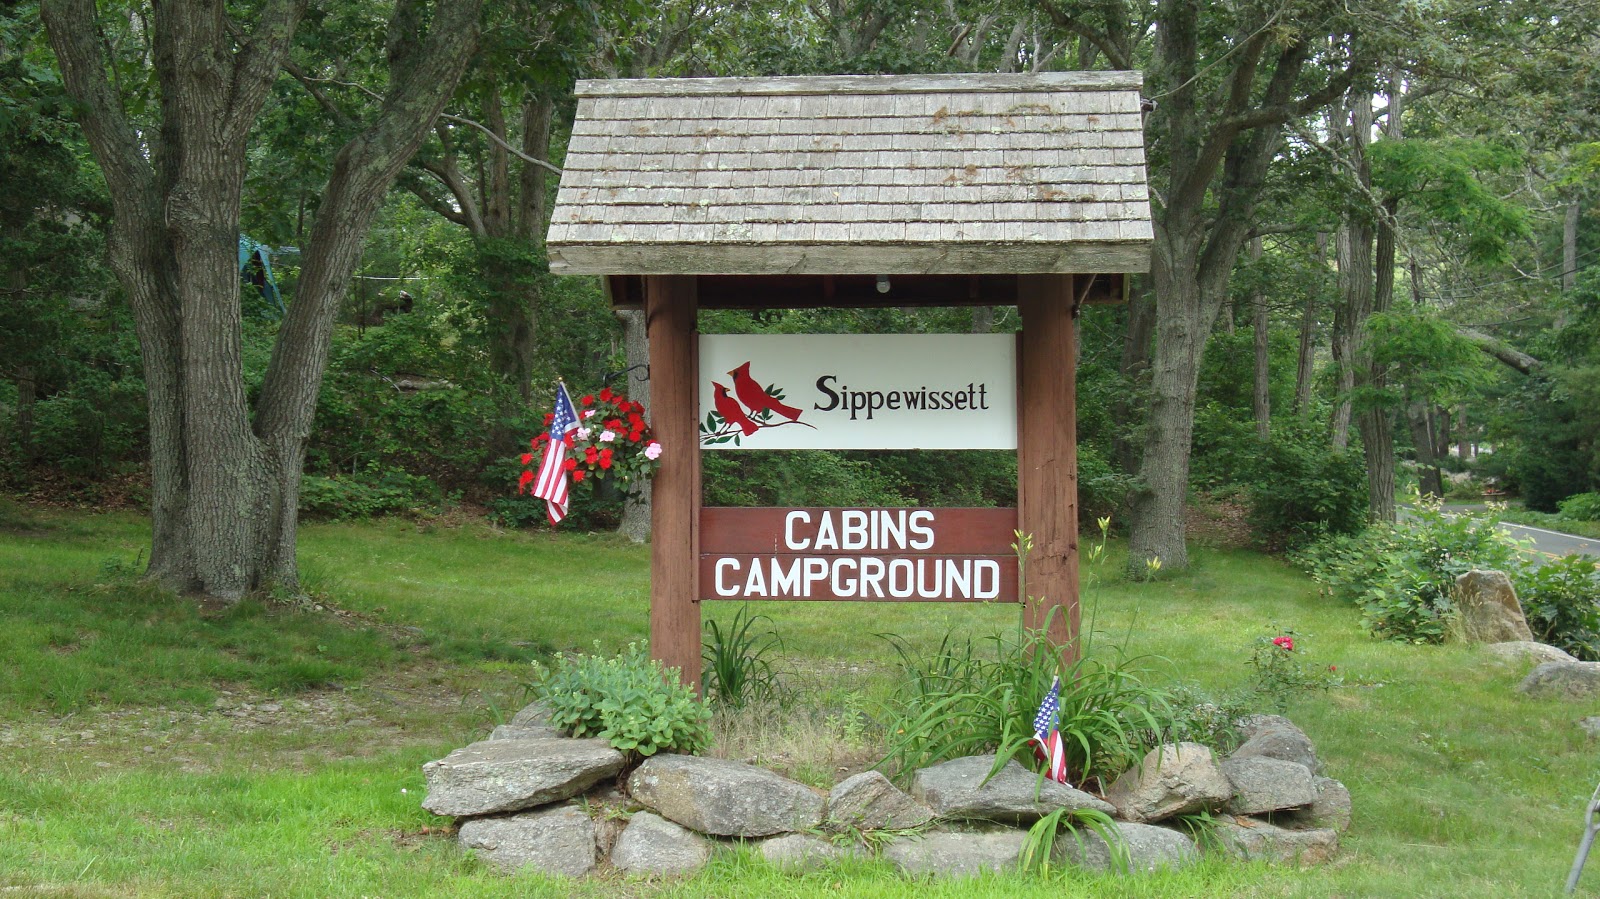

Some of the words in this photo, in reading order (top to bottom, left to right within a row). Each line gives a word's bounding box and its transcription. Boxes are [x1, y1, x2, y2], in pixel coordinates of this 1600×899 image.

[814, 375, 989, 420] Sippewissett
[785, 510, 935, 550] CABINS
[715, 557, 1000, 599] CAMPGROUND
